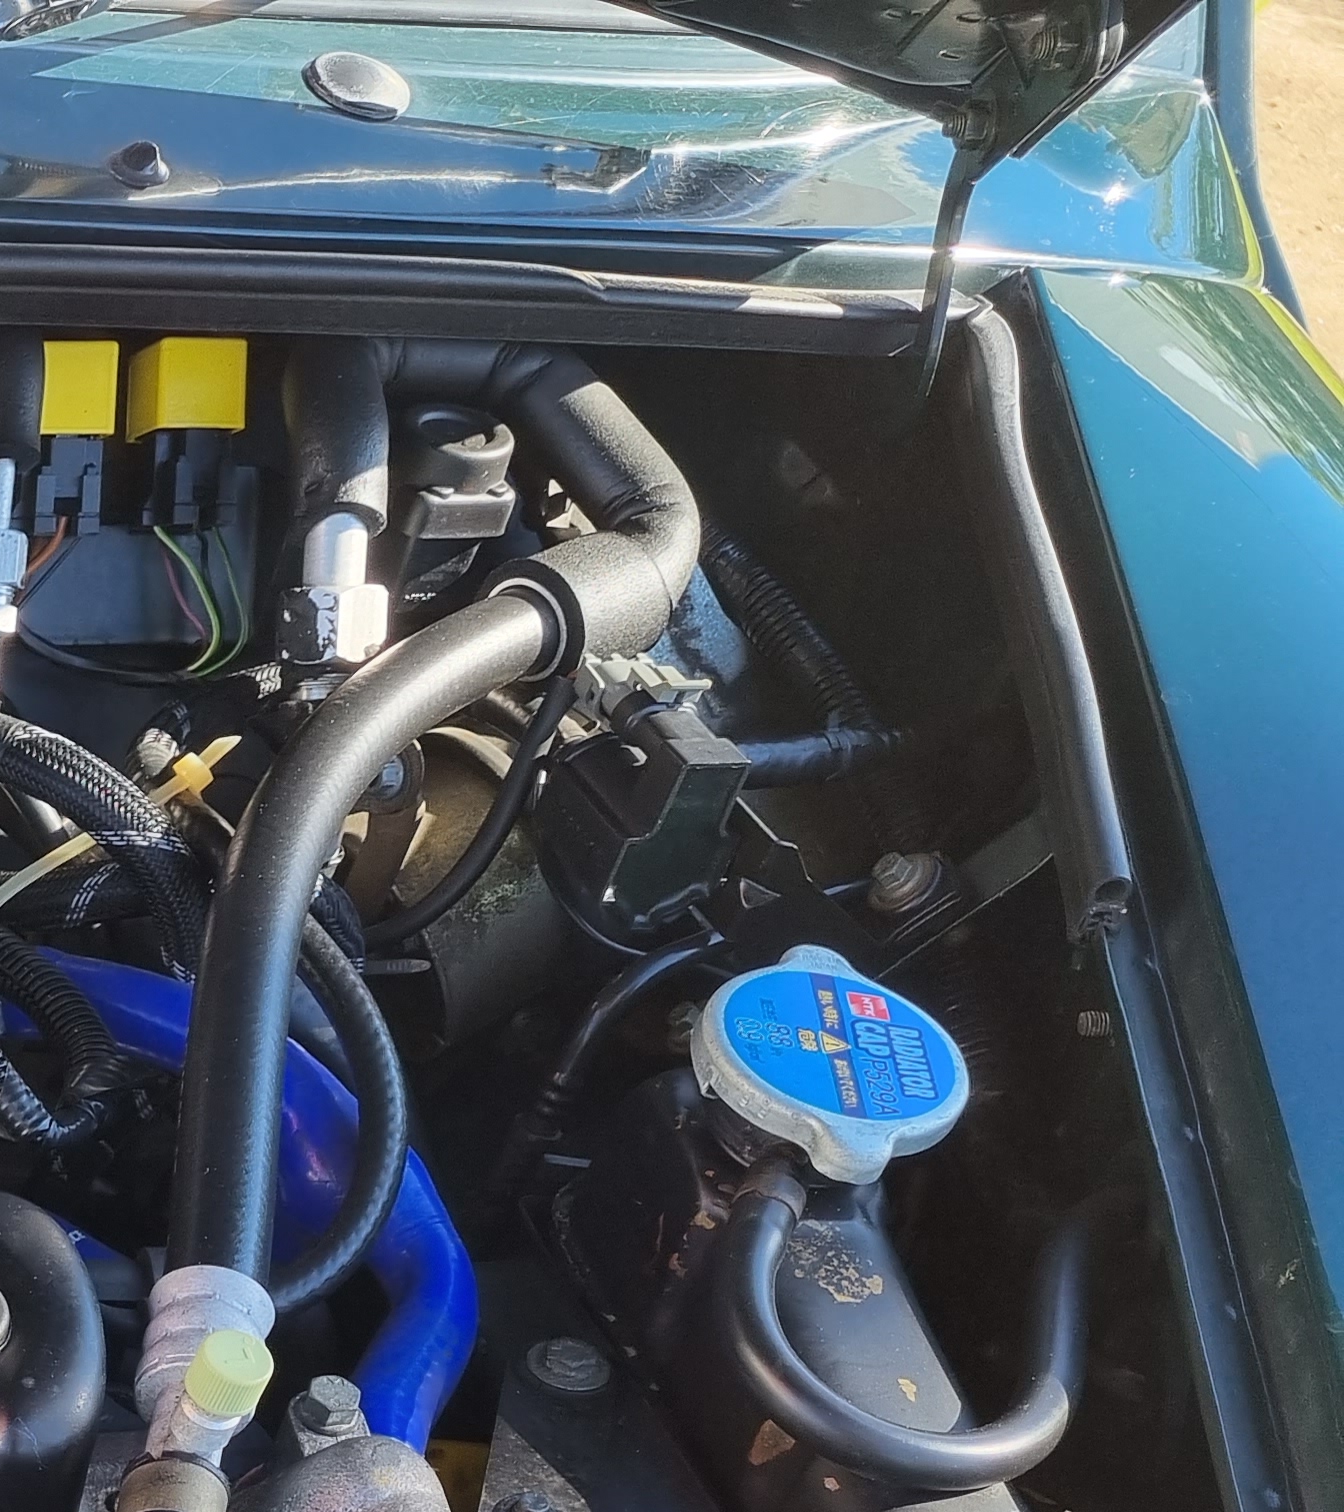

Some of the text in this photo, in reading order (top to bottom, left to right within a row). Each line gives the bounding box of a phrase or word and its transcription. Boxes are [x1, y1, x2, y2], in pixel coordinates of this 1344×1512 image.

[853, 1022, 889, 1058] CAP
[888, 1025, 938, 1100] RADIATOR
[862, 1057, 900, 1116] P529A
